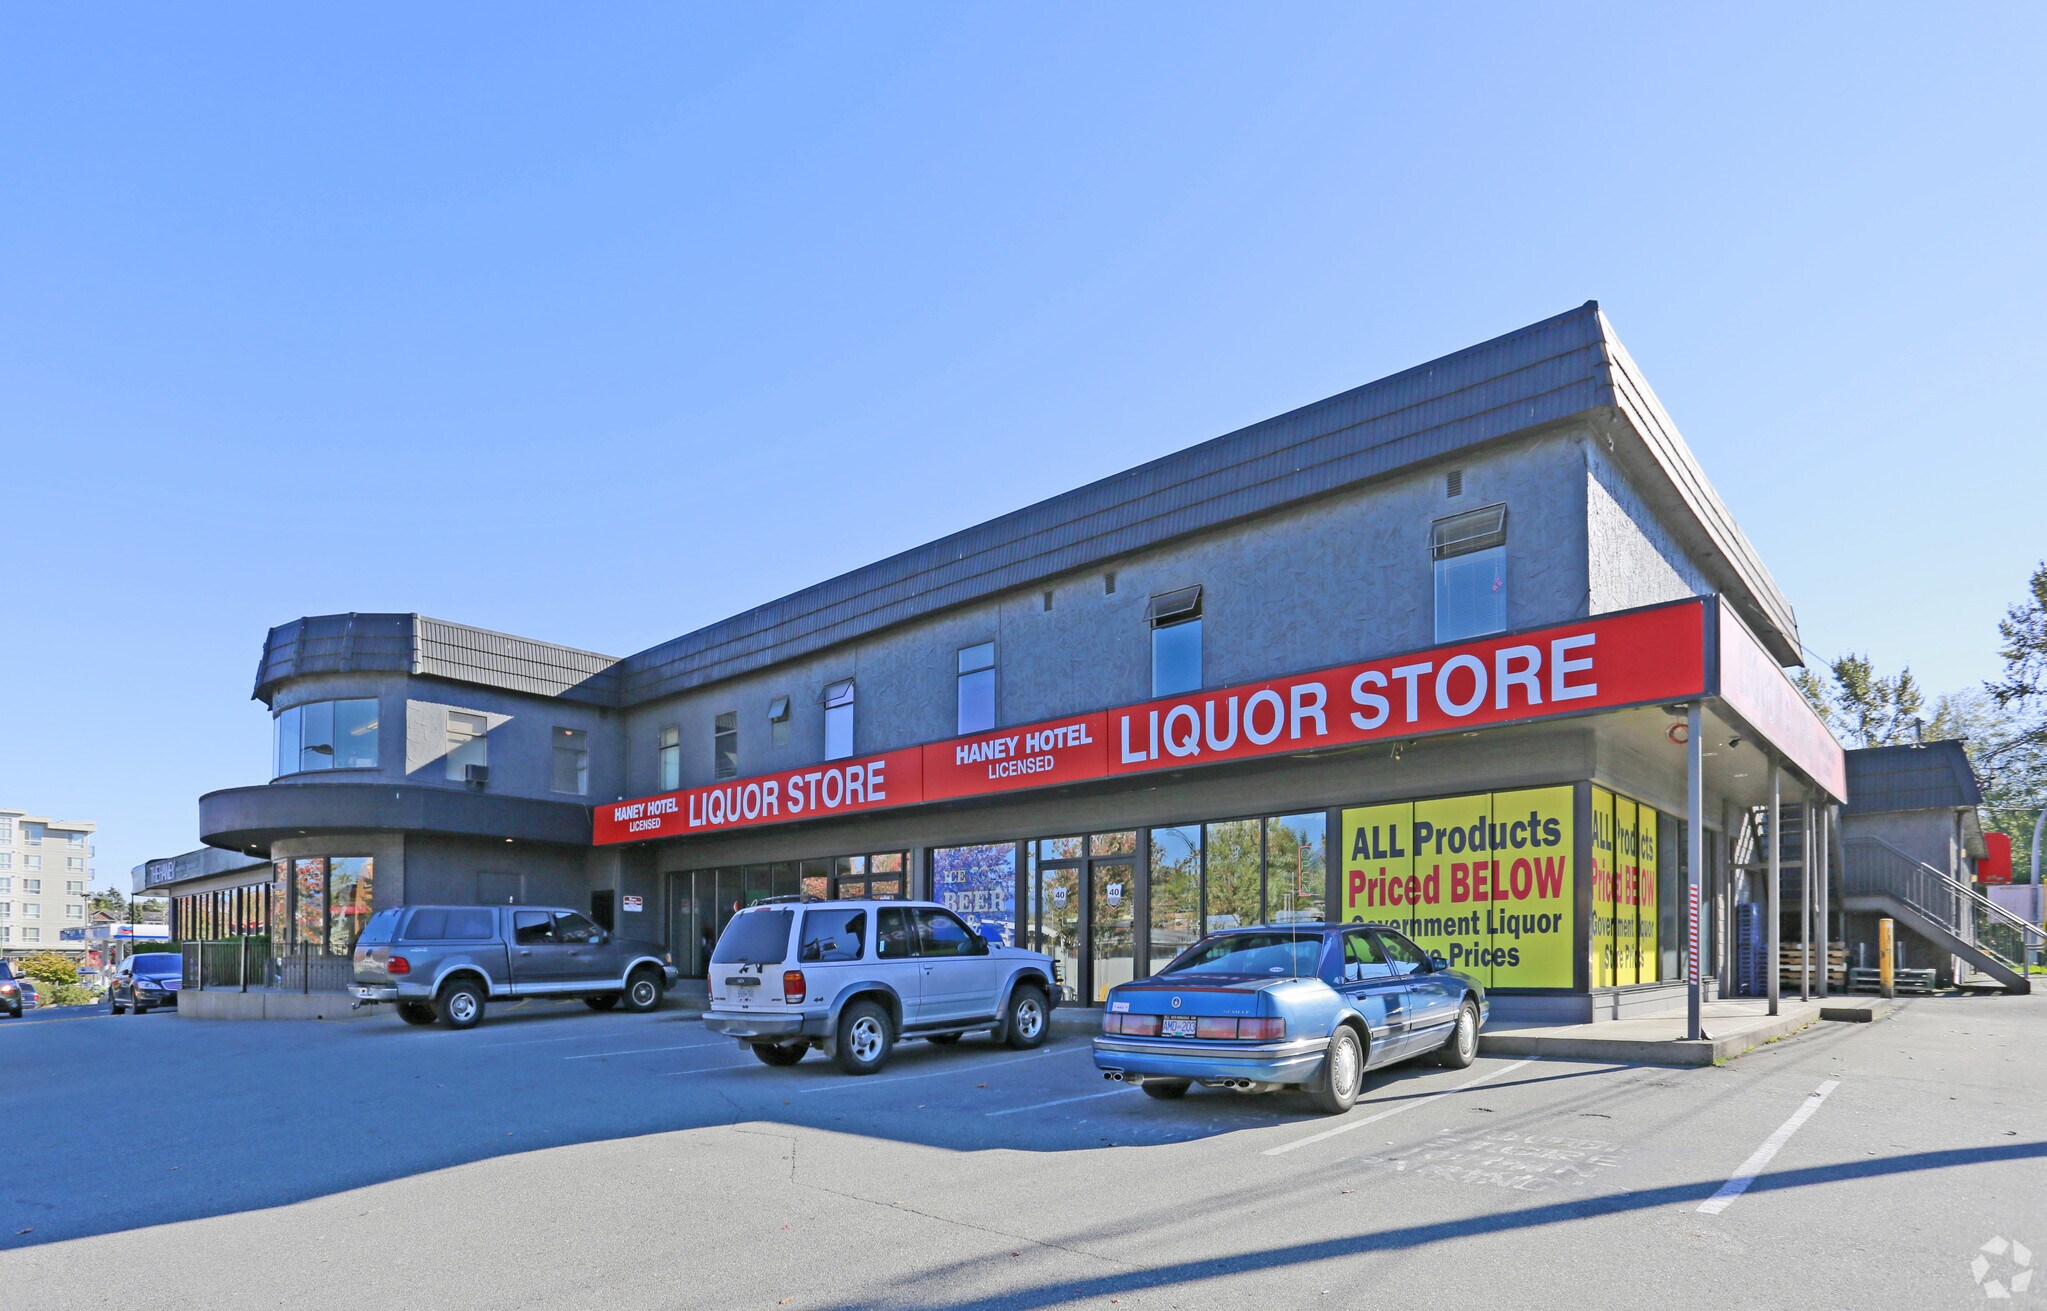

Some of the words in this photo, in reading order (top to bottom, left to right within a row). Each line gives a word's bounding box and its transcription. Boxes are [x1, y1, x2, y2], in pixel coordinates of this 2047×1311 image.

[1121, 682, 1328, 764] LIQUOR
[1350, 633, 1598, 730] STORE
[956, 735, 1019, 766] HANEY
[1026, 723, 1093, 754] HOTEL
[988, 755, 1054, 779] LICENSED
[689, 780, 778, 827] LIQUOR
[787, 760, 885, 813] STORE
[614, 803, 645, 821] HANEY
[648, 797, 678, 816] HOTEL
[629, 817, 661, 832] LICENSED
[1352, 824, 1405, 861] ALL
[1414, 811, 1562, 857] Products
[1592, 809, 1612, 851] ALL
[1617, 818, 1654, 862] rodcts
[943, 869, 966, 883] ICE
[1349, 865, 1440, 908] Priced
[1450, 855, 1566, 904] BELOW
[1625, 863, 1655, 908] BEOW
[943, 889, 1006, 913] BEER
[1055, 891, 1065, 899] 40
[1109, 888, 1119, 896] 40
[1352, 911, 1480, 937] ernment
[1486, 908, 1562, 940] Liquor
[1592, 909, 1634, 938] Goverment
[1449, 942, 1520, 969] Prices
[1604, 944, 1622, 969] Stre
